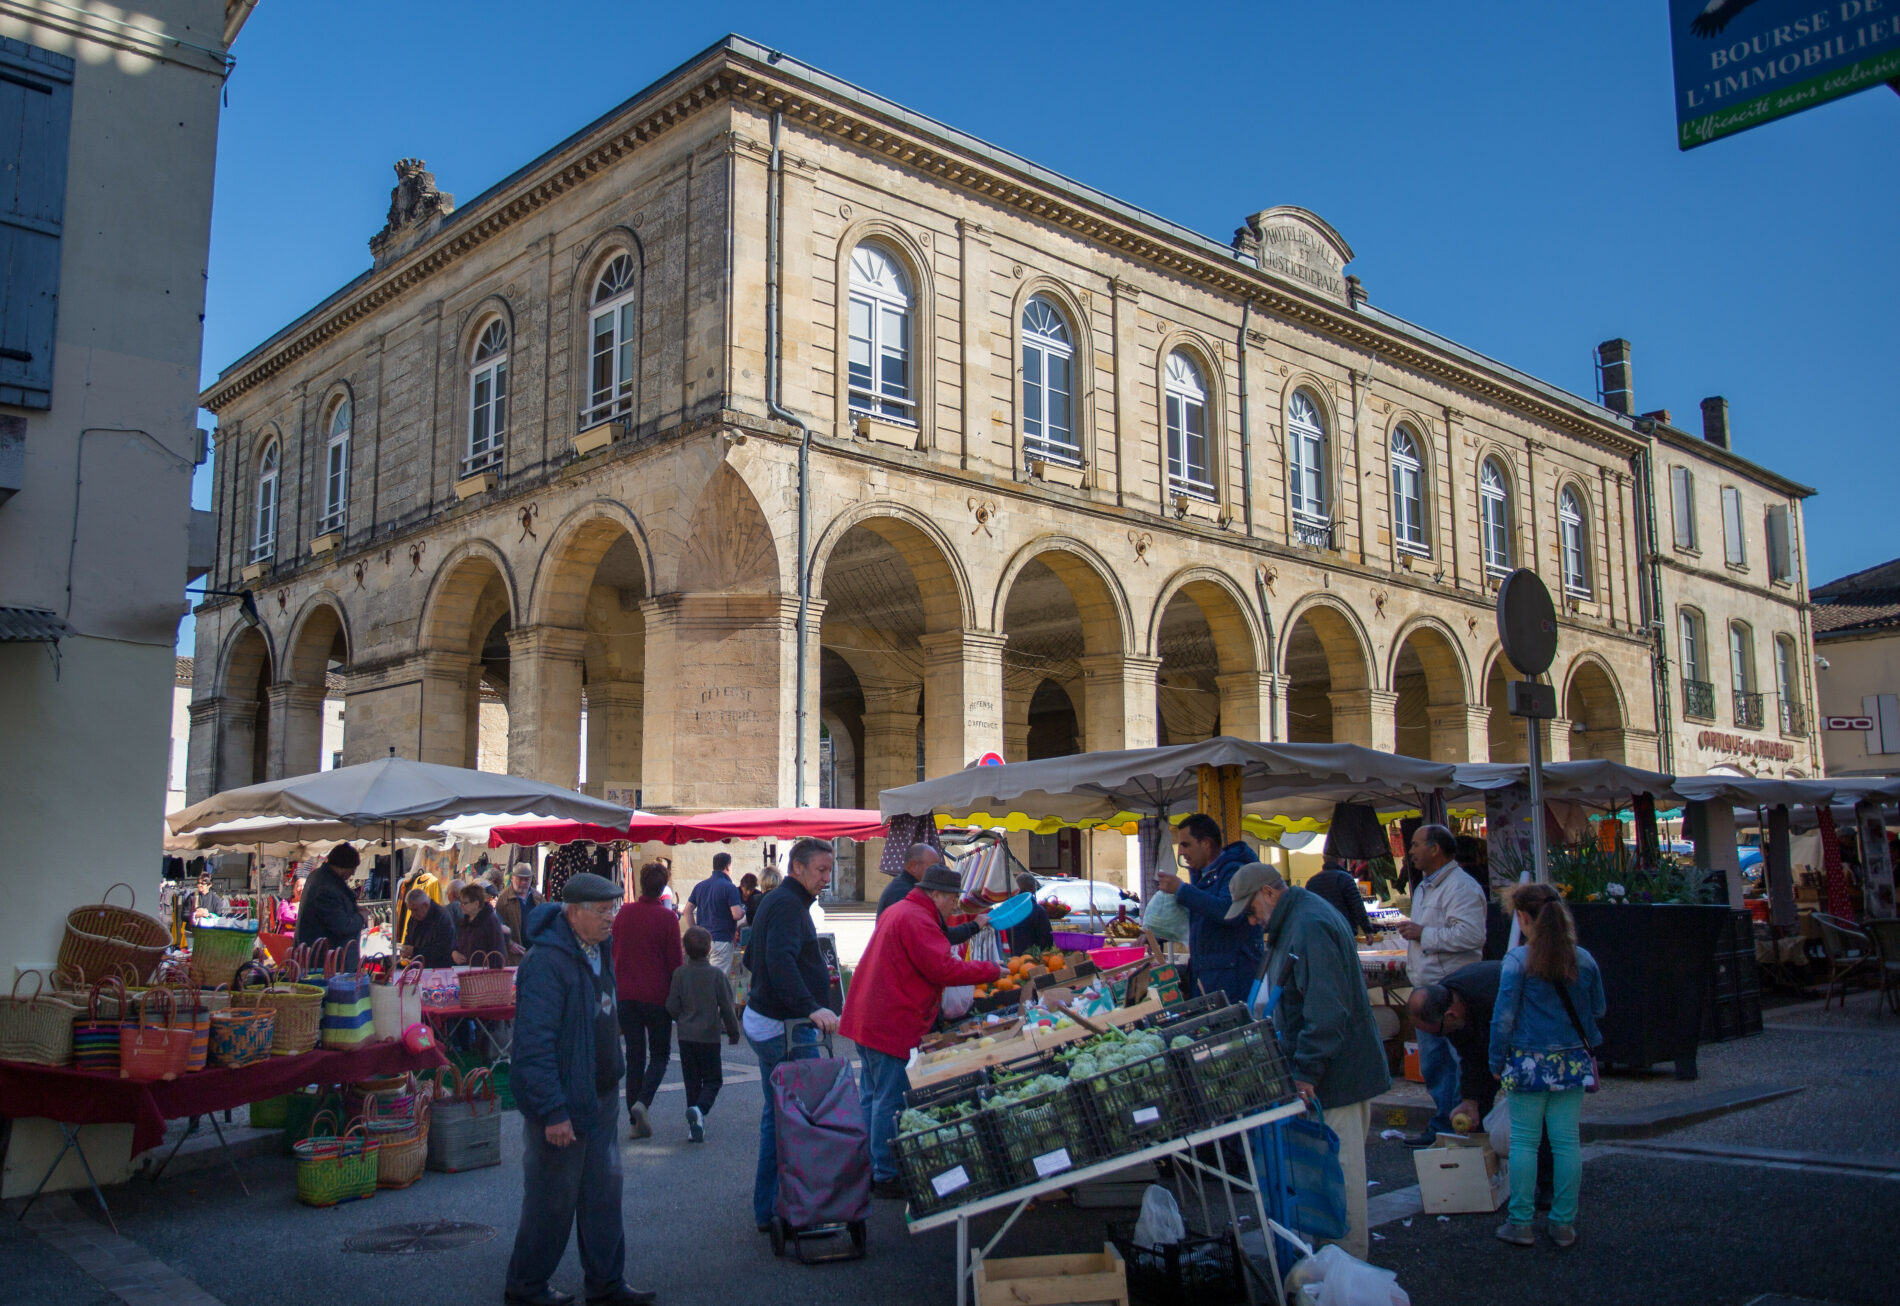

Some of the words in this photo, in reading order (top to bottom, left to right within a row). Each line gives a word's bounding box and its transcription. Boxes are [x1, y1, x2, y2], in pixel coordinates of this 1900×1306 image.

[1711, 10, 1831, 70] BOURSE
[1683, 95, 1770, 141] L'efficacité
[1778, 86, 1818, 109] sans
[1267, 251, 1305, 279] JUSTICE
[1300, 248, 1310, 262] ET
[1699, 731, 1743, 752] OPTIQUE
